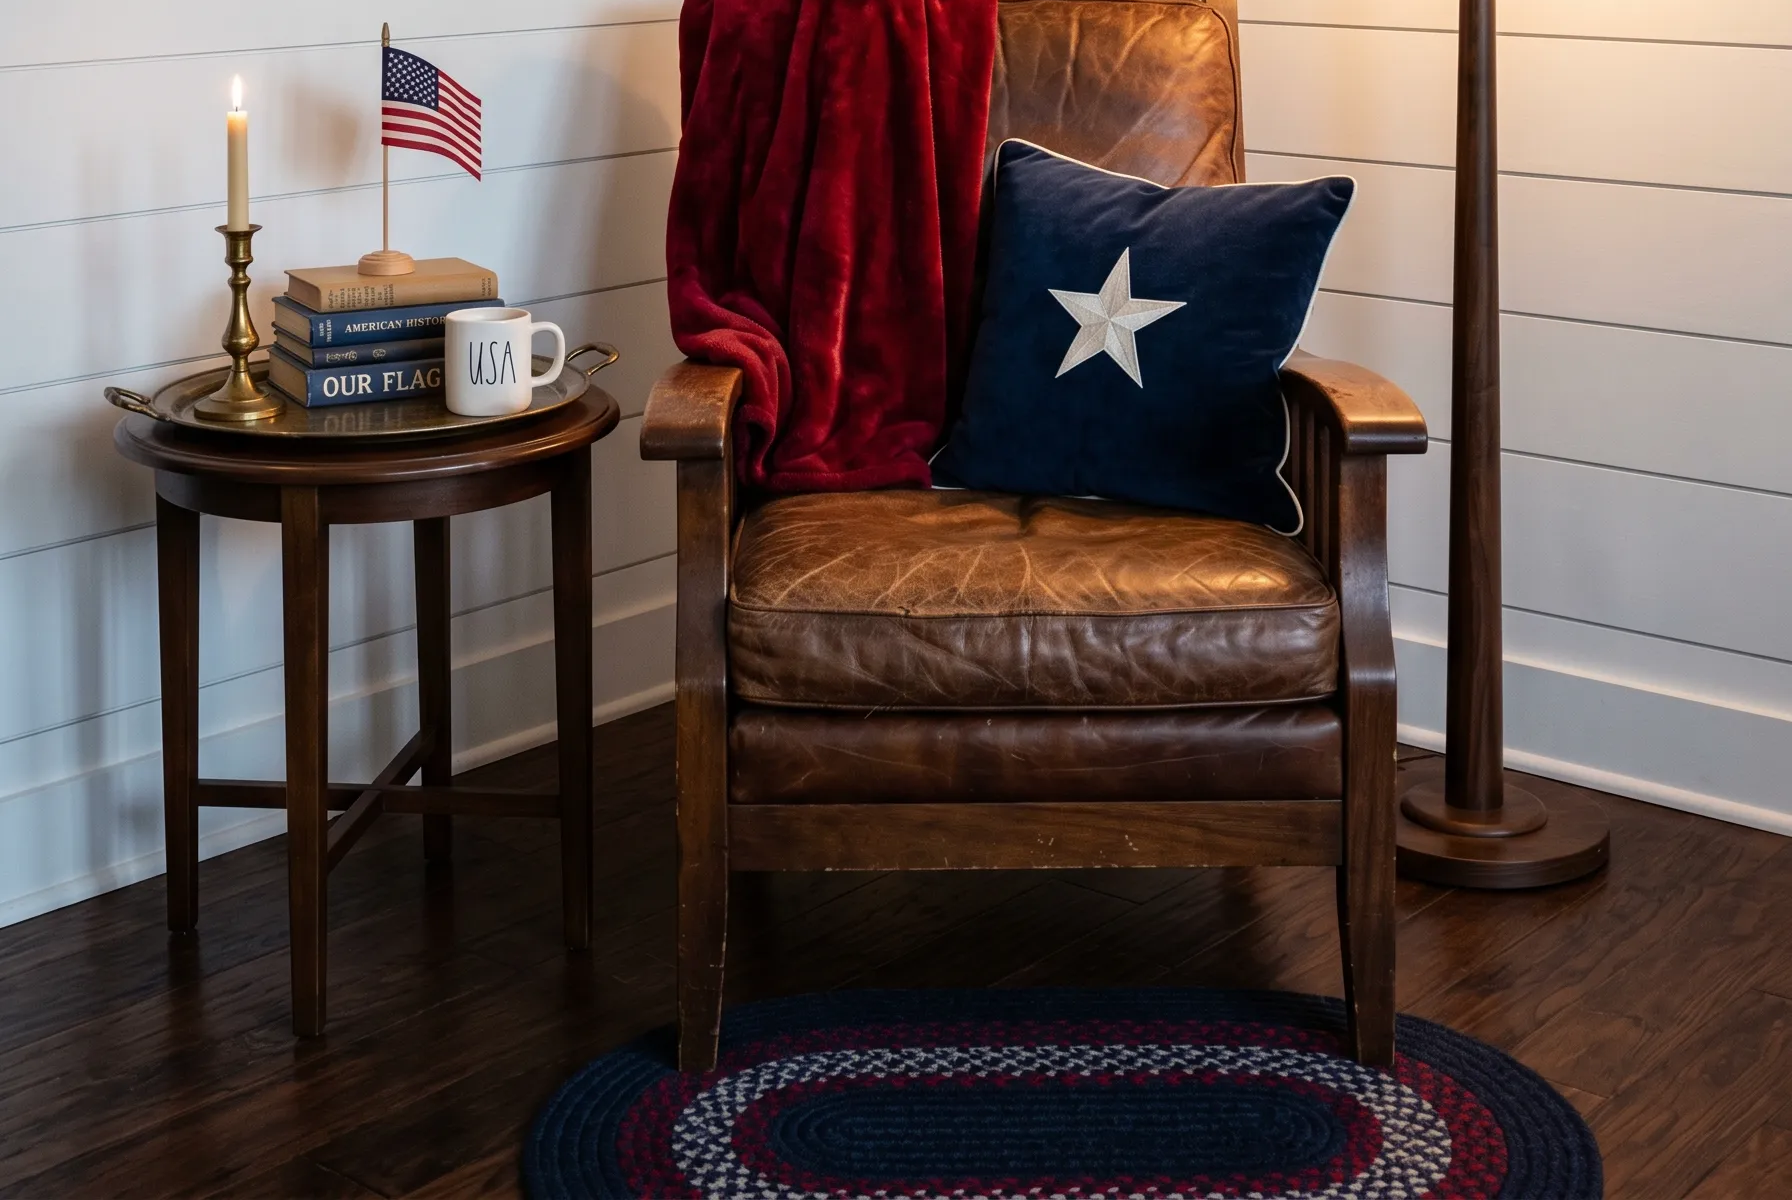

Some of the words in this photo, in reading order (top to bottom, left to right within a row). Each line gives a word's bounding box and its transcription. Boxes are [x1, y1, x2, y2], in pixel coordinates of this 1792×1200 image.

[344, 320, 402, 334] AMERICAN
[406, 316, 446, 328] HISTOR
[469, 341, 516, 385] USA
[323, 373, 373, 398] OUR
[382, 367, 441, 392] FLAG
